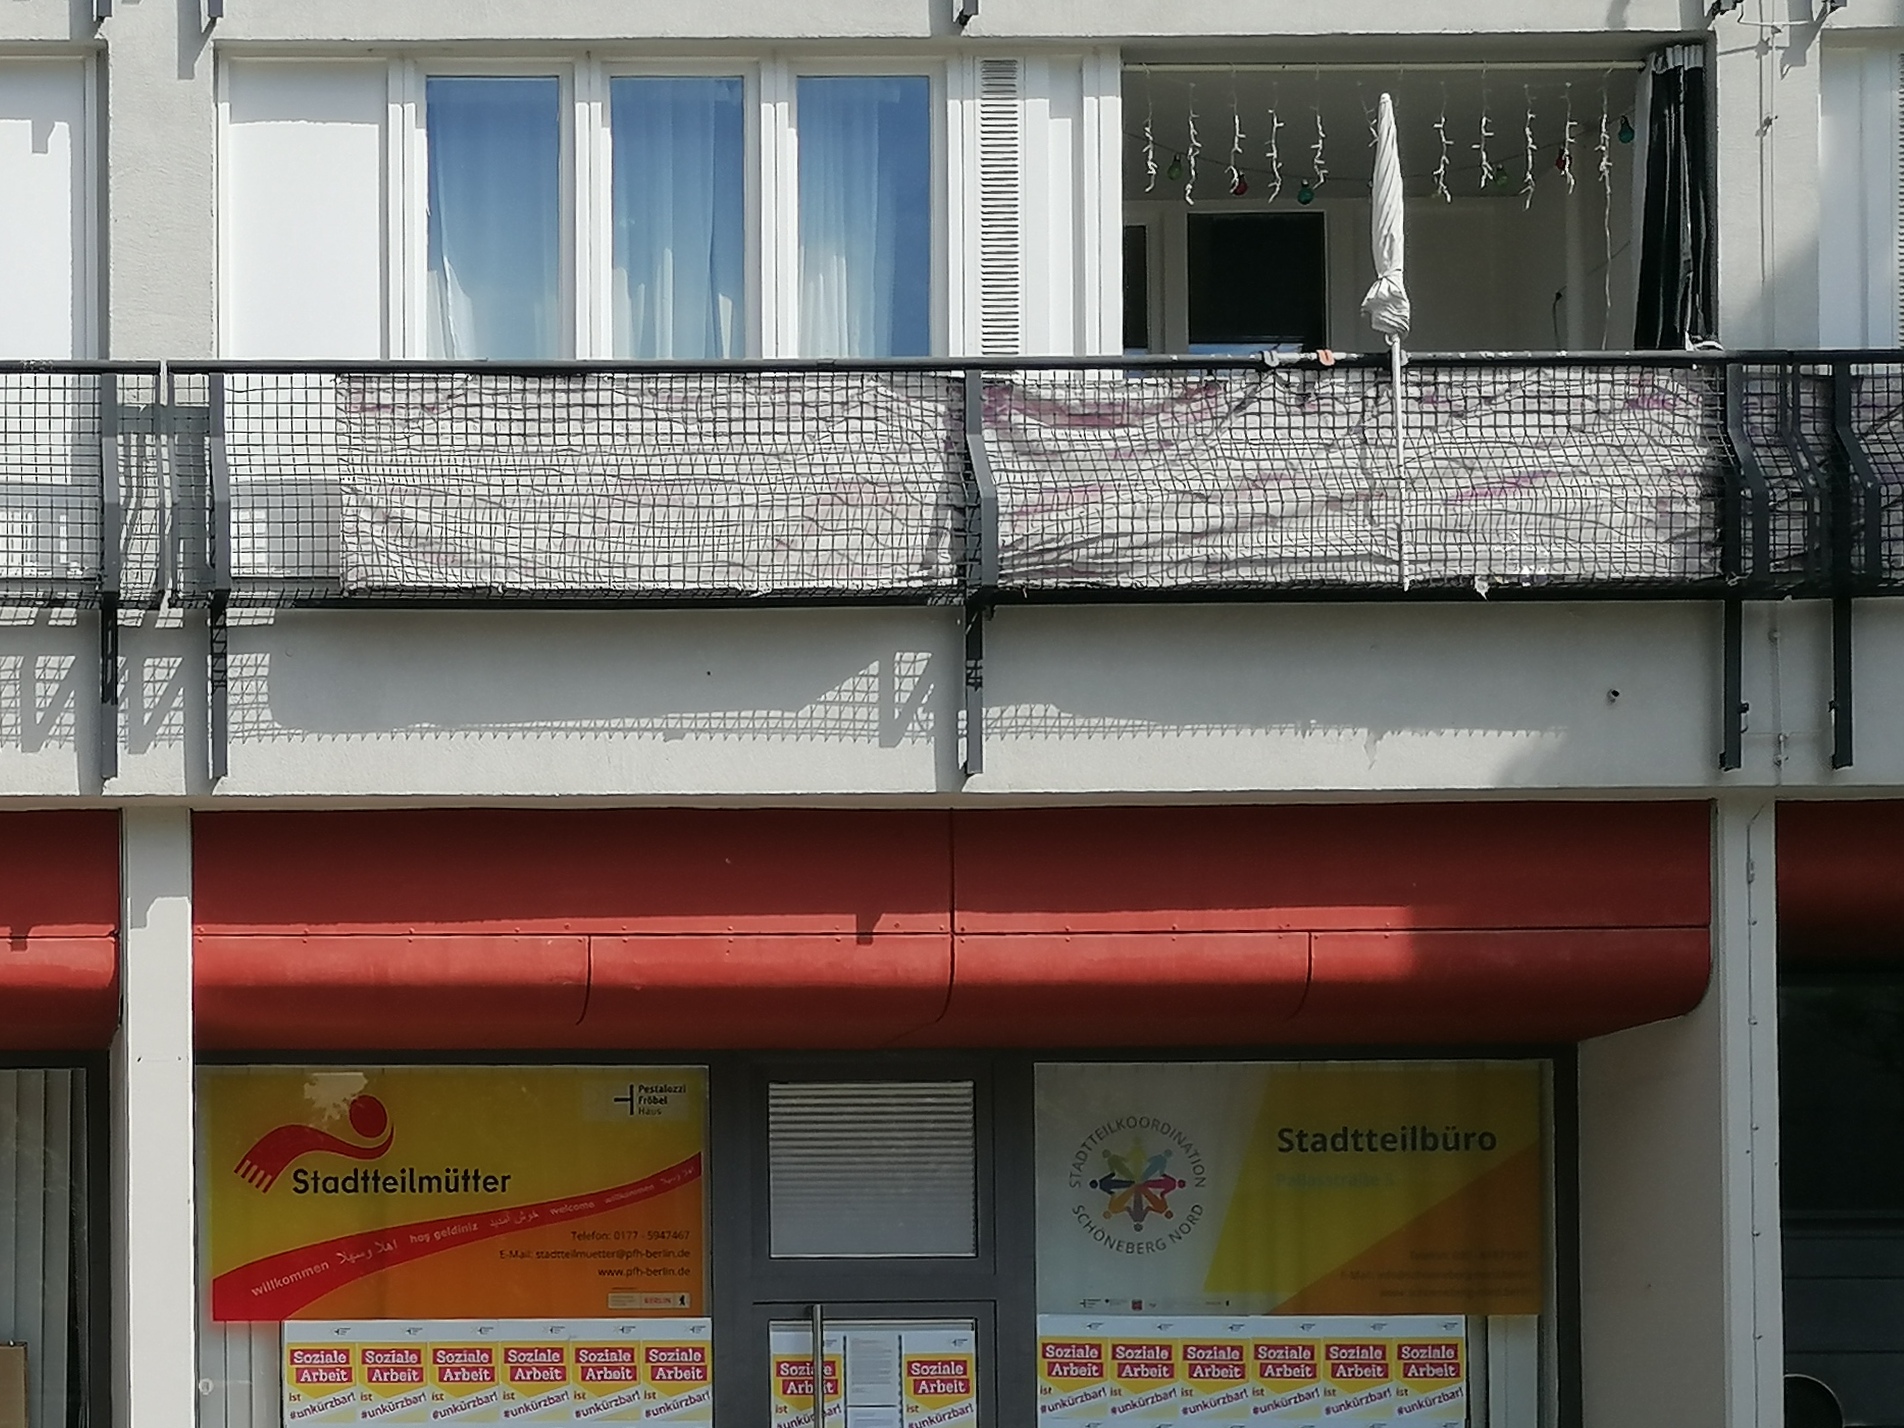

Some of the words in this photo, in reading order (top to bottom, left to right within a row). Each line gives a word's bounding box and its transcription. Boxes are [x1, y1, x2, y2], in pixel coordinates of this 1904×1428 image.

[638, 1084, 686, 1094] Pestalozzi
[638, 1095, 668, 1105] Fröbel
[638, 1107, 662, 1116] Haus
[1278, 1126, 1497, 1152] Stadtteilbüro
[1069, 1116, 1206, 1188] STADTTEILKOORDINATION
[293, 1167, 511, 1193] Stadtteilmütter
[549, 1201, 595, 1216] welcome
[570, 1230, 610, 1241] Telefon:
[614, 1231, 638, 1241] 0177
[1072, 1205, 1167, 1254] SCHÖNEBERG
[1168, 1204, 1203, 1243] NORD
[251, 1260, 330, 1297] willkommen
[598, 1267, 691, 1278] www.pfh-berlin.de
[293, 1351, 346, 1365] Soziale
[365, 1350, 418, 1364] Soziale
[436, 1350, 489, 1364] Soziale
[507, 1349, 560, 1363] Soziale
[578, 1349, 631, 1363] Soziale
[649, 1349, 702, 1363] Soziale
[1045, 1345, 1098, 1359] Soziale
[1116, 1346, 1169, 1360] Soziale
[1187, 1346, 1240, 1360] Soziale
[1258, 1346, 1311, 1360] Soziale
[1329, 1346, 1382, 1360] Soziale
[1401, 1346, 1454, 1360] Soziale
[300, 1369, 348, 1382] Arbeit
[372, 1369, 420, 1382] Arbeit
[443, 1368, 491, 1381] Arbeit
[514, 1367, 562, 1380] Arbeit
[585, 1367, 633, 1380] Arbeit
[655, 1367, 703, 1380] Arbeit
[910, 1362, 964, 1376] Soziale
[1051, 1363, 1100, 1376] Arbeit
[1121, 1364, 1170, 1377] Arbeit
[1193, 1364, 1242, 1377] Arbeit
[1264, 1364, 1313, 1377] Arbeit
[1335, 1364, 1384, 1377] Arbeit
[1407, 1364, 1456, 1377] Arbeit
[918, 1380, 966, 1393] Arbeit
